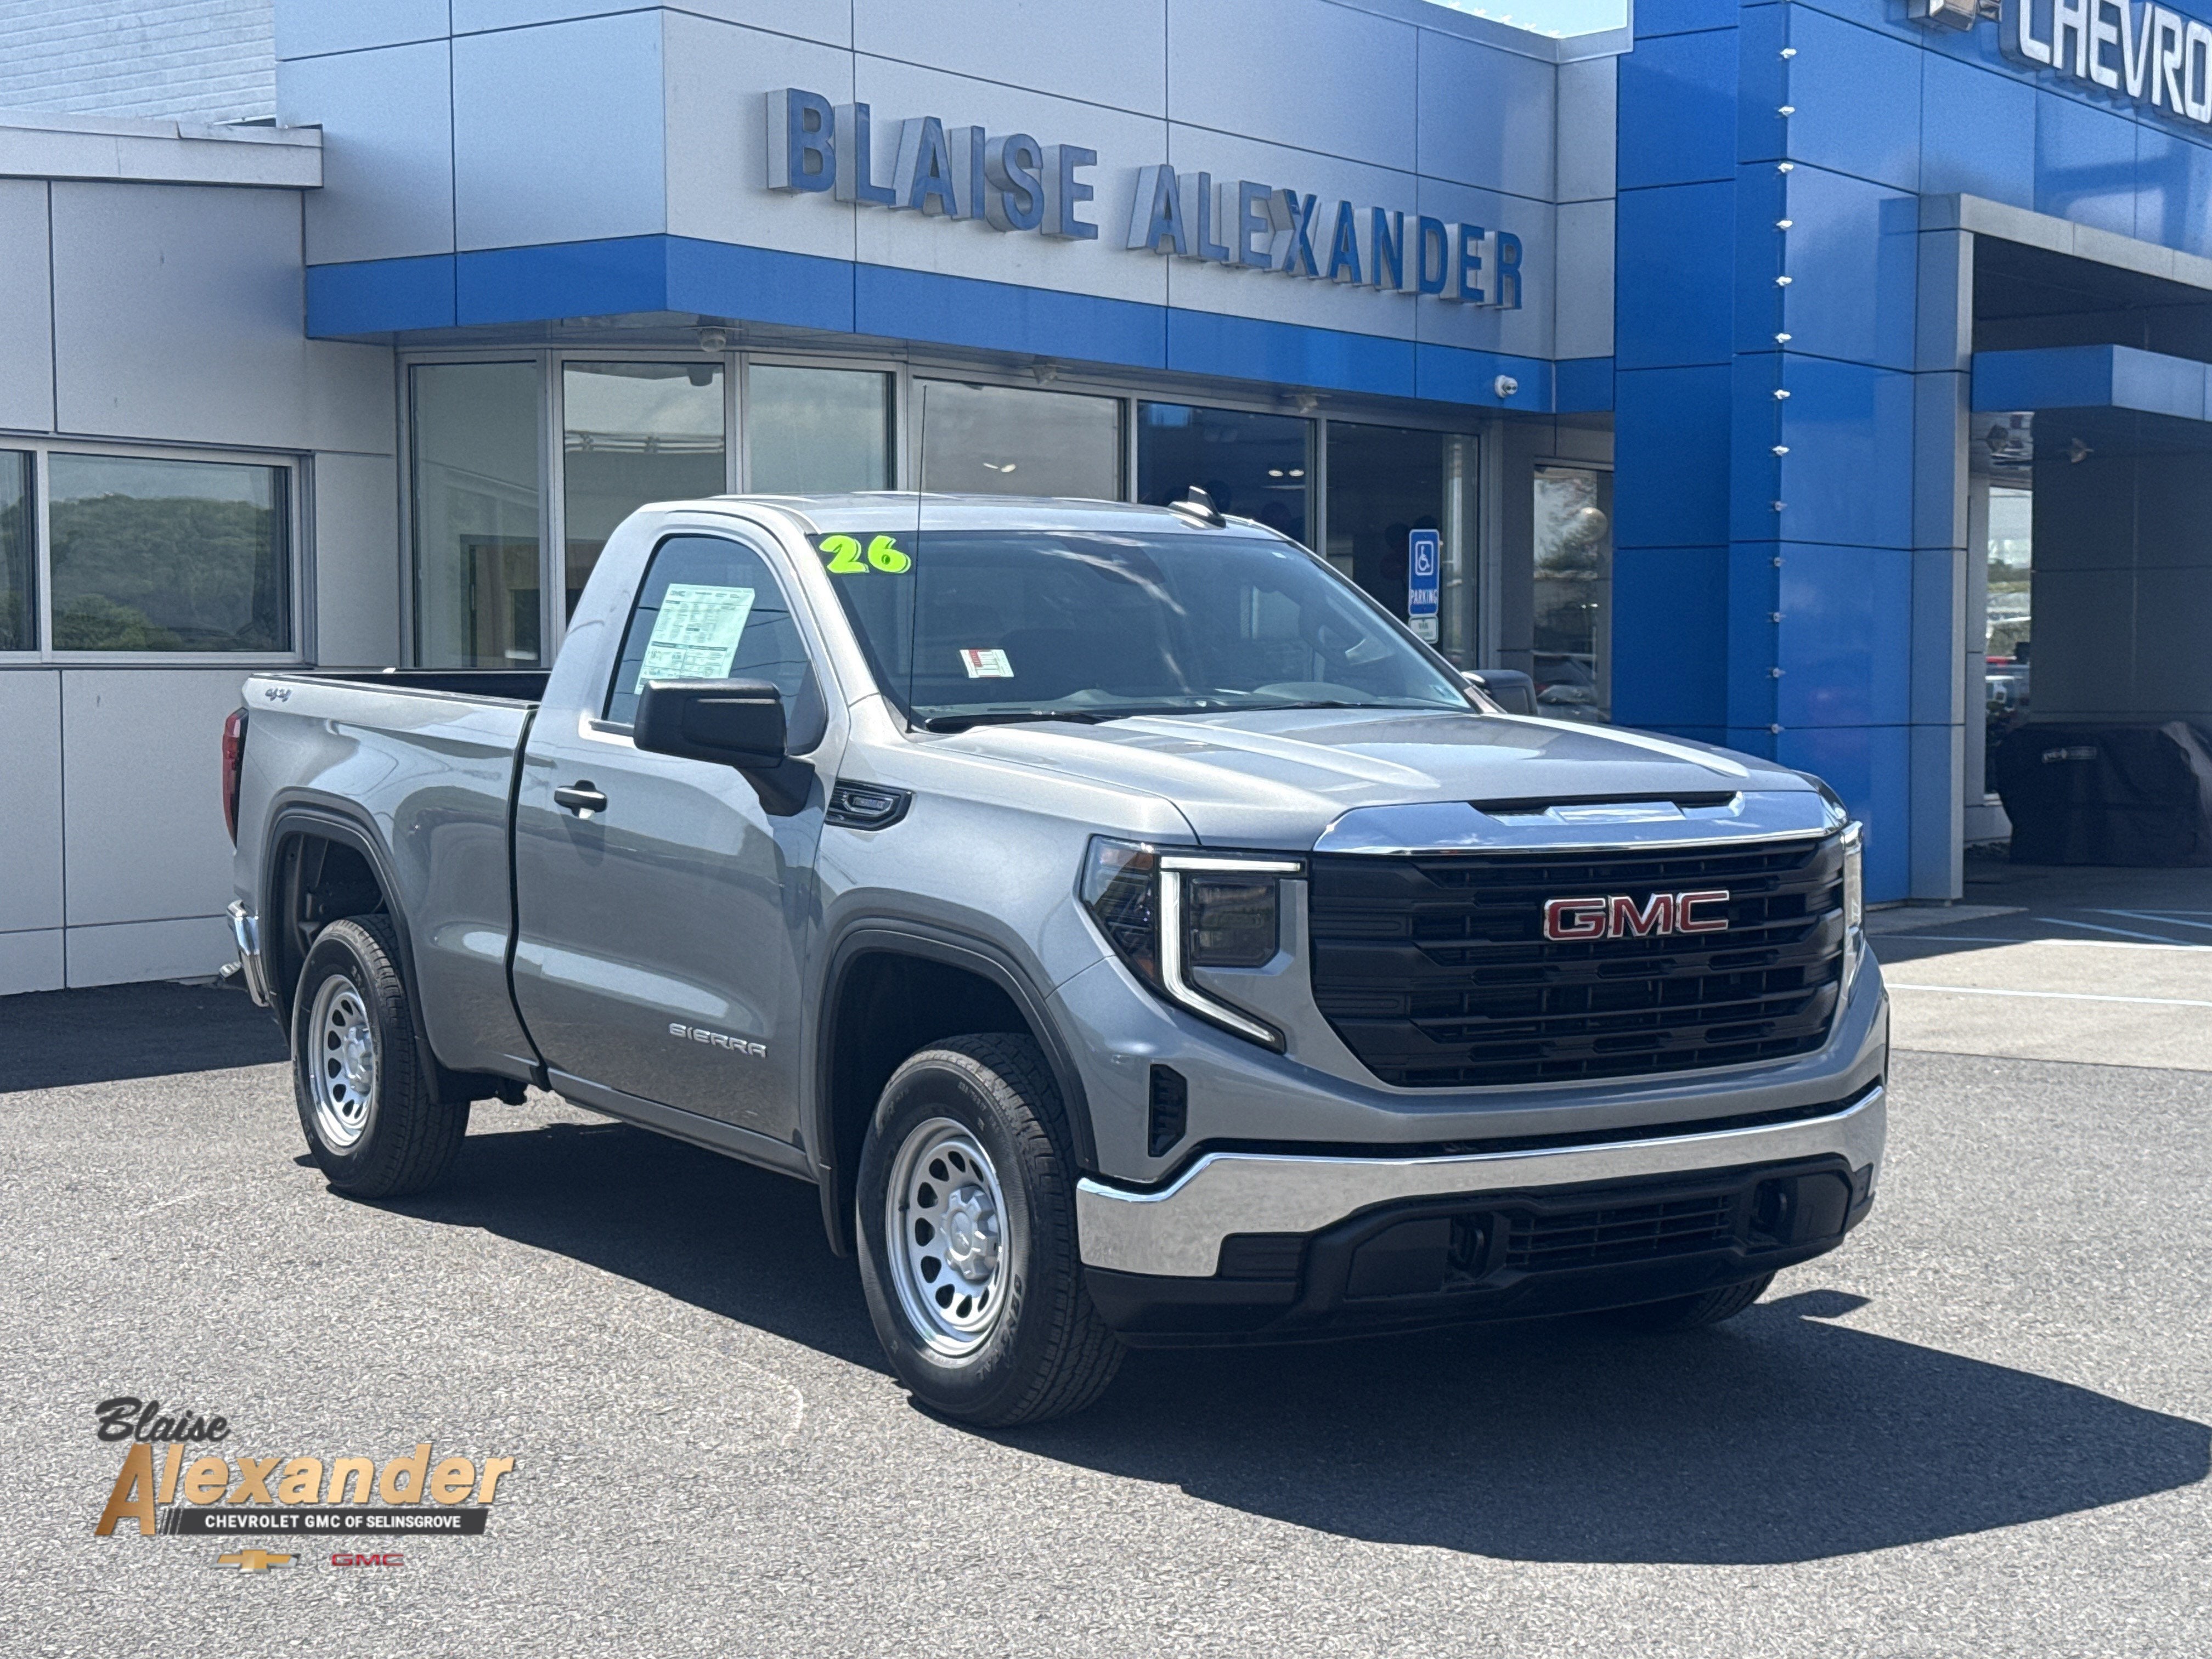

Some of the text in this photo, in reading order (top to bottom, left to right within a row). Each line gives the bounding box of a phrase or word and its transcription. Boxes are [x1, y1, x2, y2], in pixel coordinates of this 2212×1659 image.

[769, 88, 1523, 310] BLAISE ALEXANDER
[819, 535, 911, 573] 26
[1409, 589, 1438, 604] PARKING
[1544, 890, 1730, 941] GMC
[669, 1023, 768, 1058] SIERRA
